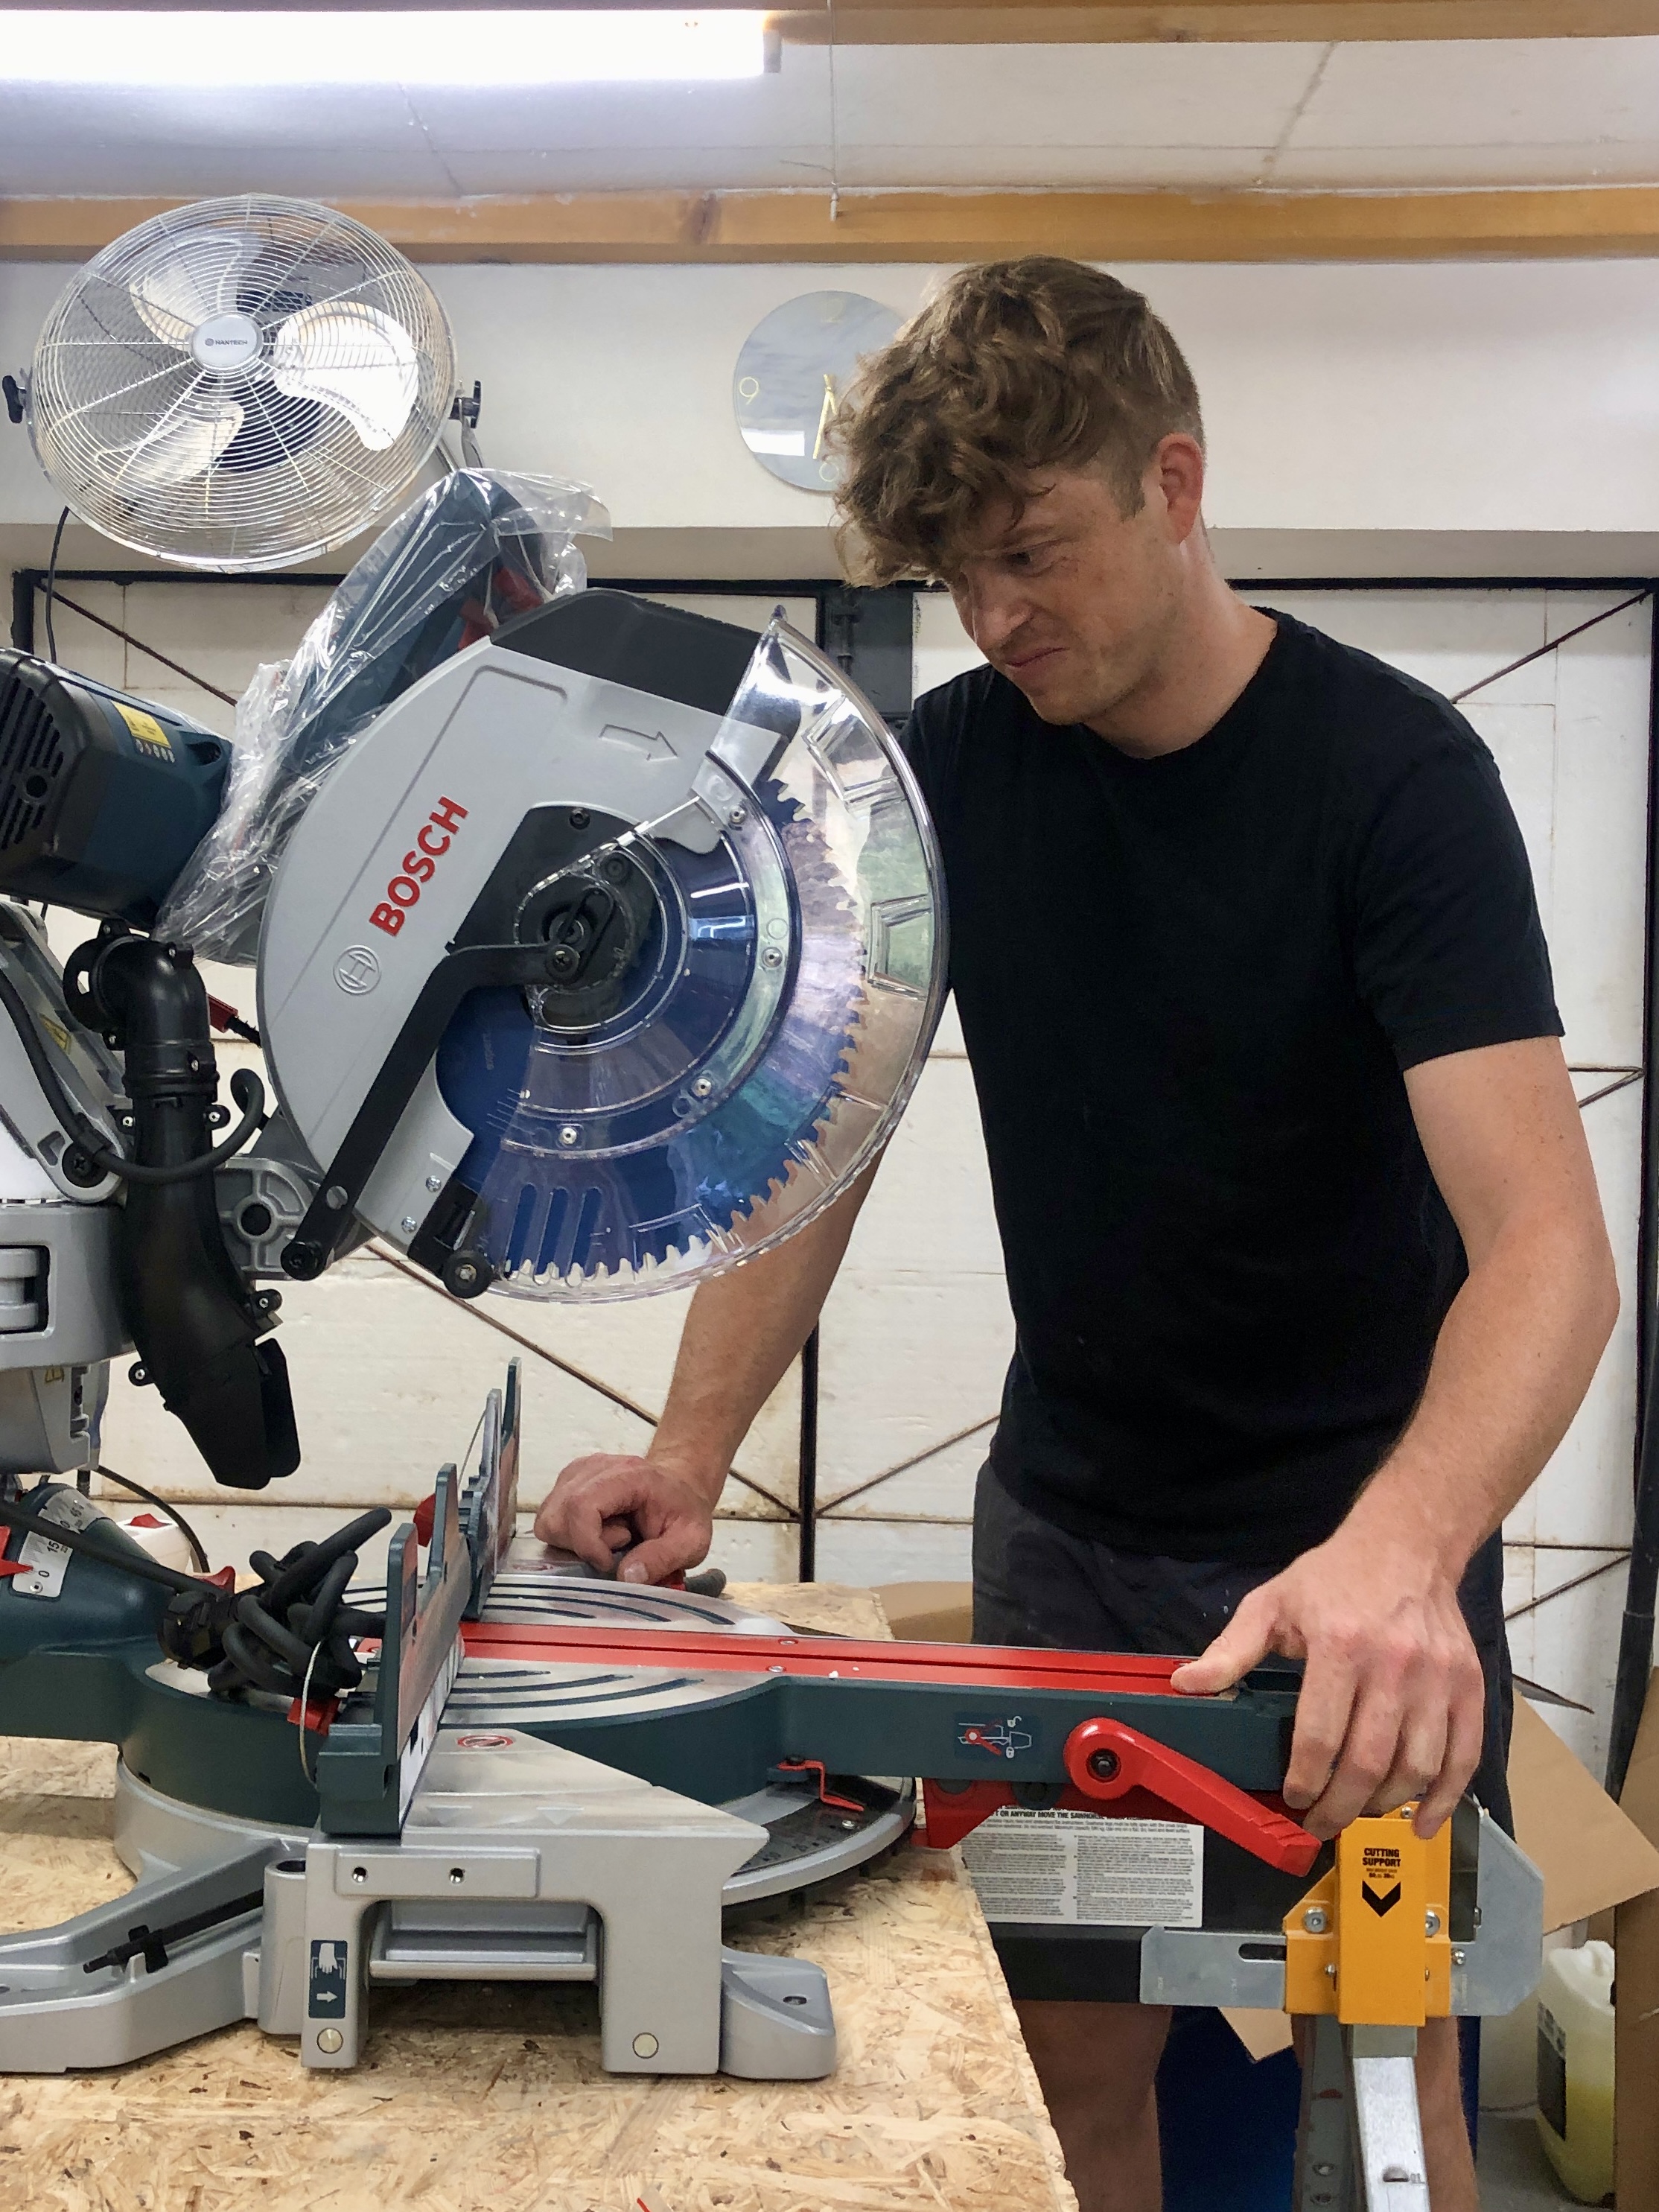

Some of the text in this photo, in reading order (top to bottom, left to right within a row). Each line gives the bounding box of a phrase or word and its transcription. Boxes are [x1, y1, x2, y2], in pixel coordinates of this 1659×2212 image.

[739, 376, 759, 405] 9
[369, 795, 470, 937] BOSCH
[47, 1540, 60, 1553] 15
[38, 1570, 50, 1578] 0
[1364, 1848, 1400, 1857] CUTTING
[1362, 1857, 1401, 1867] SUPPORT
